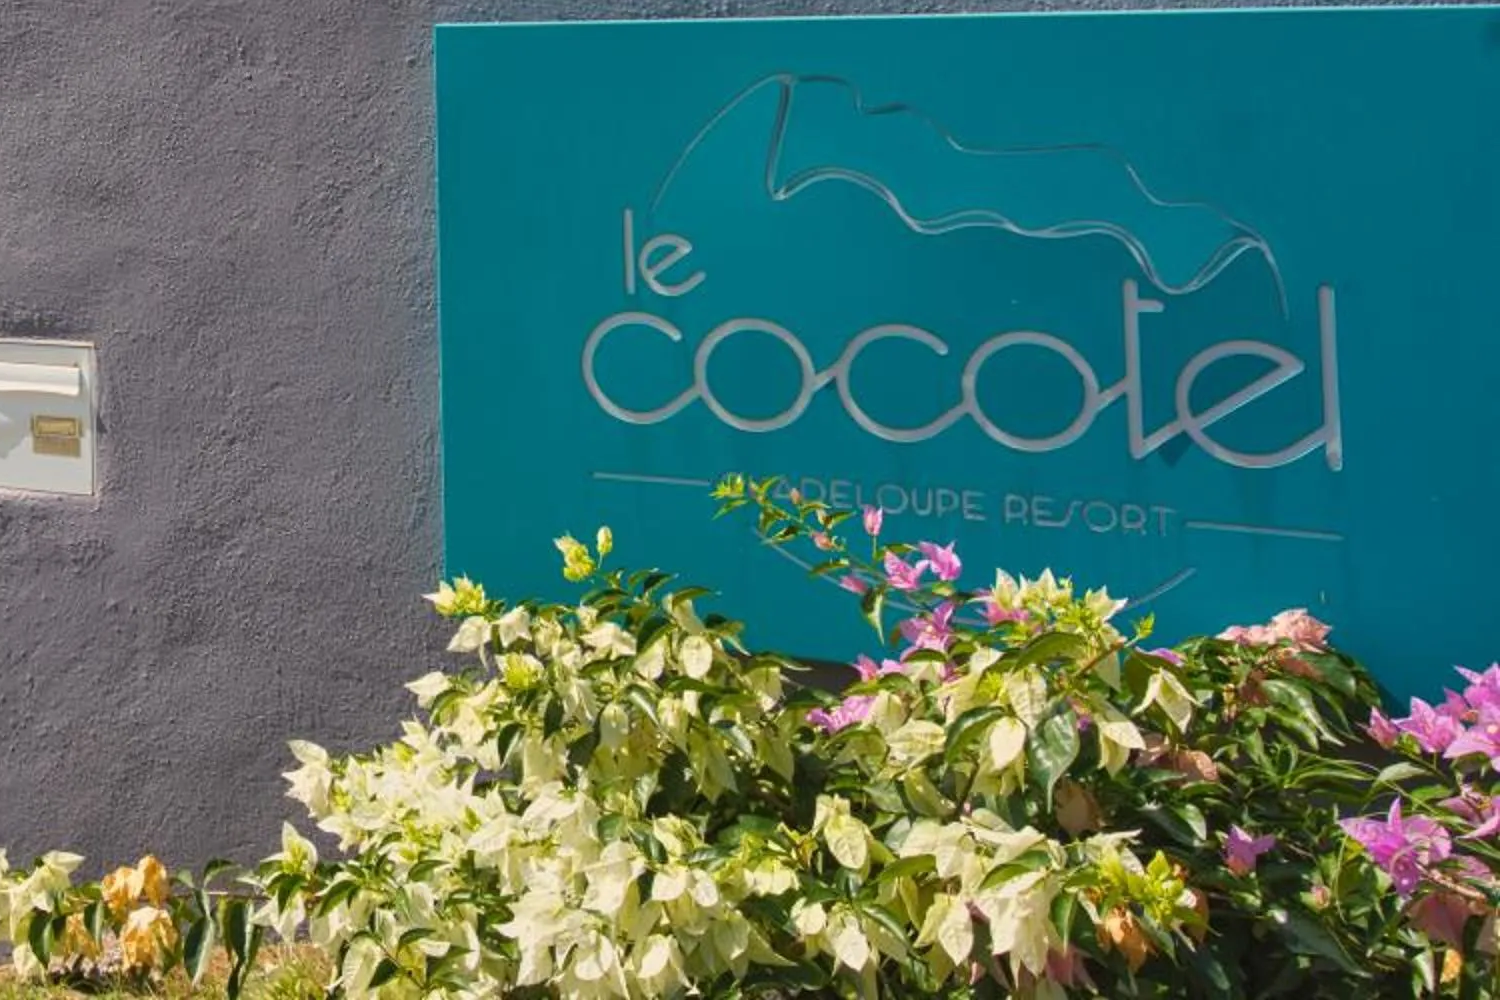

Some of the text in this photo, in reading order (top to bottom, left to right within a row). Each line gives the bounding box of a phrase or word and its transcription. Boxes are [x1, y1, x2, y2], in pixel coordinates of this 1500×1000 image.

[623, 207, 707, 296] le
[582, 278, 1343, 472] cocotel
[1004, 492, 1179, 538] RESORT
